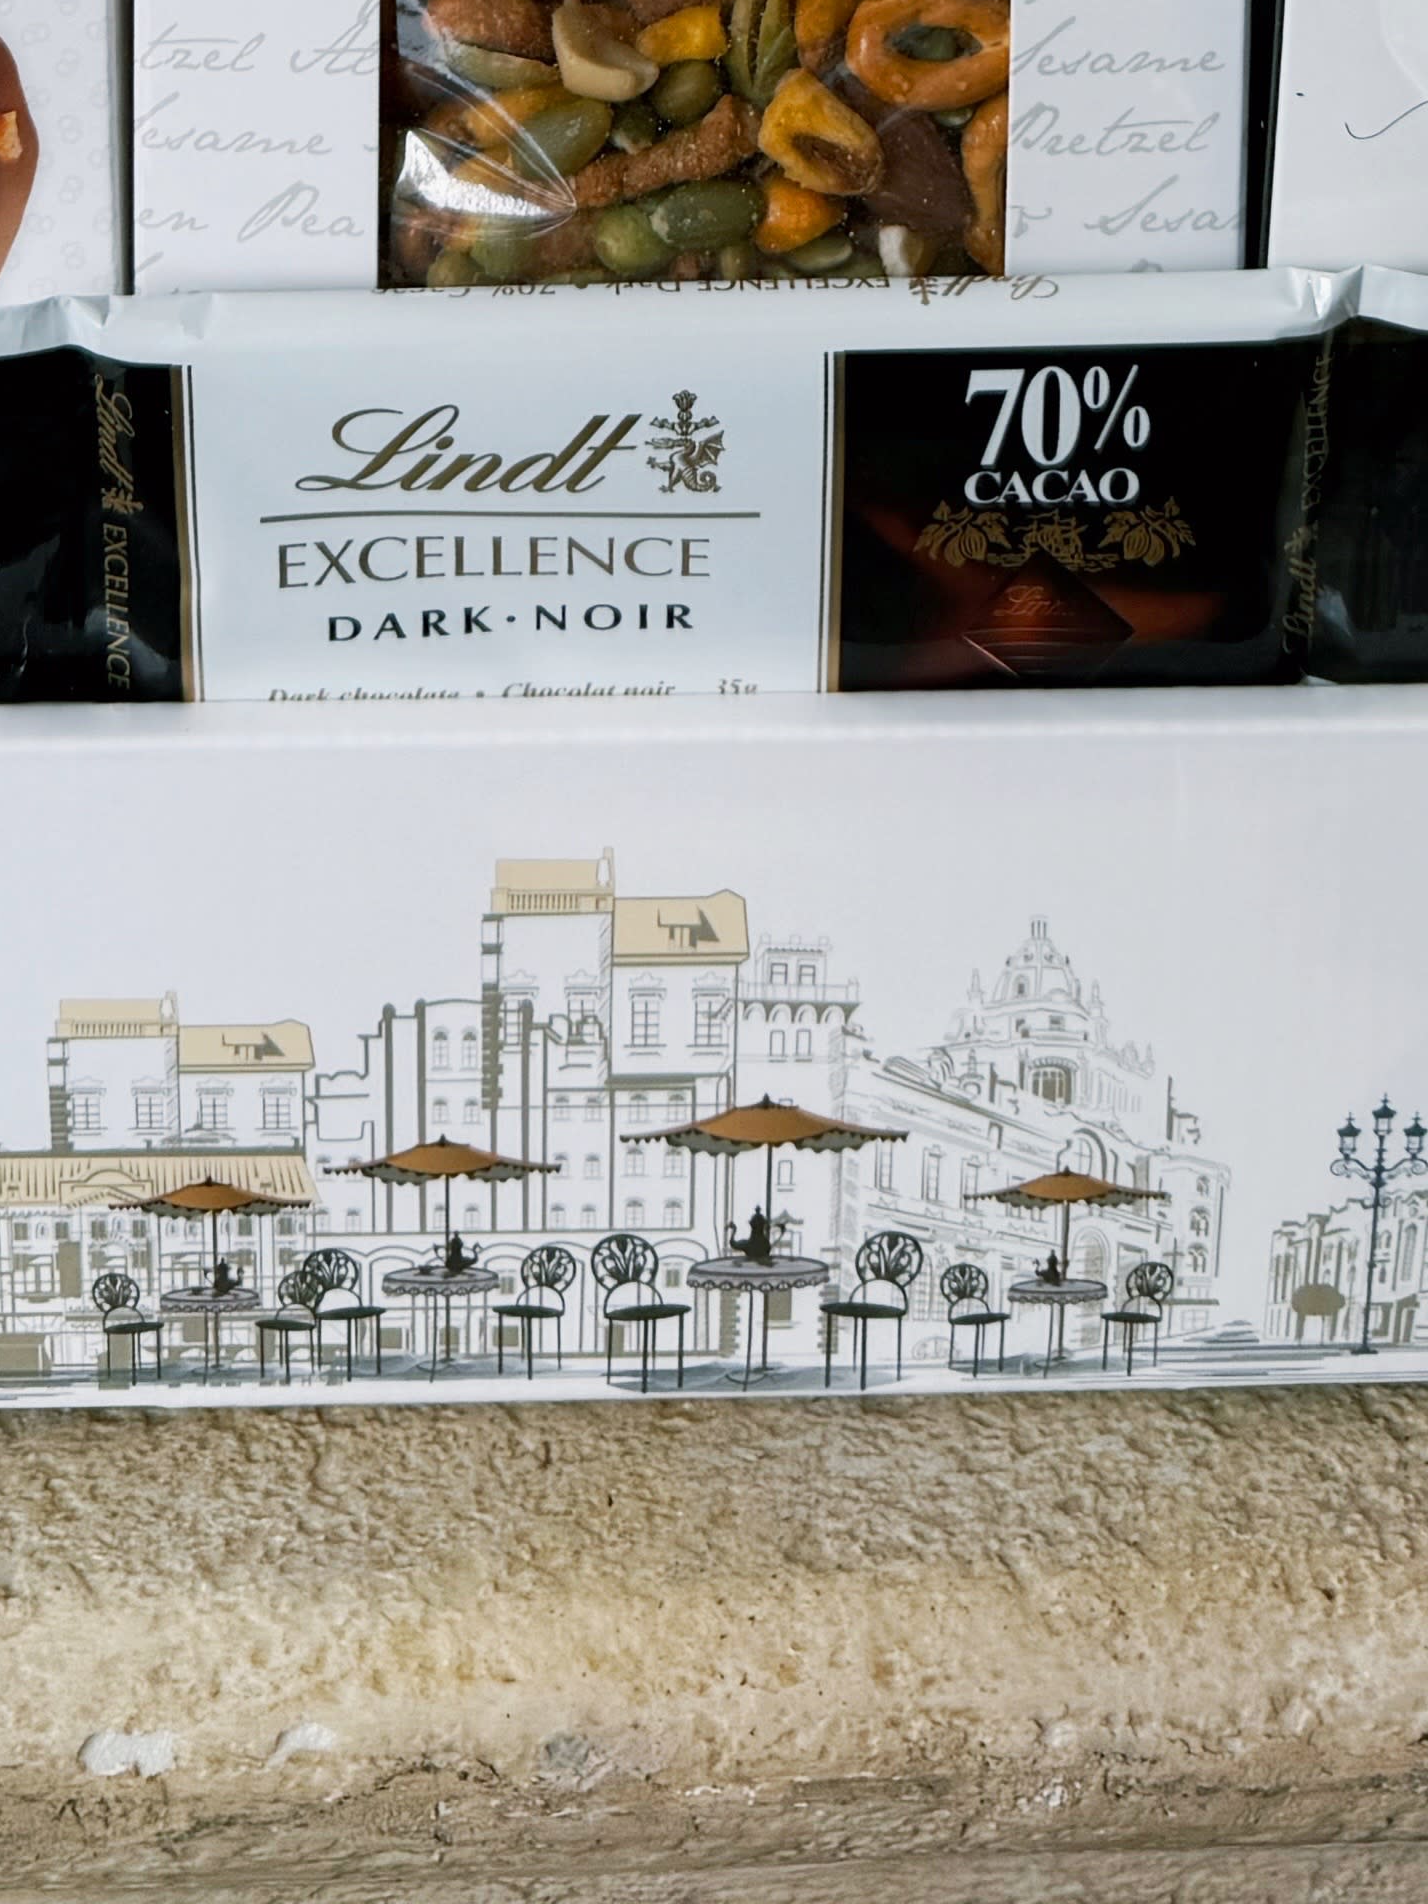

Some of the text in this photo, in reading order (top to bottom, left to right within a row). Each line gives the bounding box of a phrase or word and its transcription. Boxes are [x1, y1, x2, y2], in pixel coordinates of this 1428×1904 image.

[294, 403, 643, 494] Lindt
[964, 364, 1151, 468] 70%
[94, 373, 136, 690] Lindt EXCELLENCE
[964, 466, 1140, 507] CACAO
[277, 535, 712, 589] EXCELLENCE
